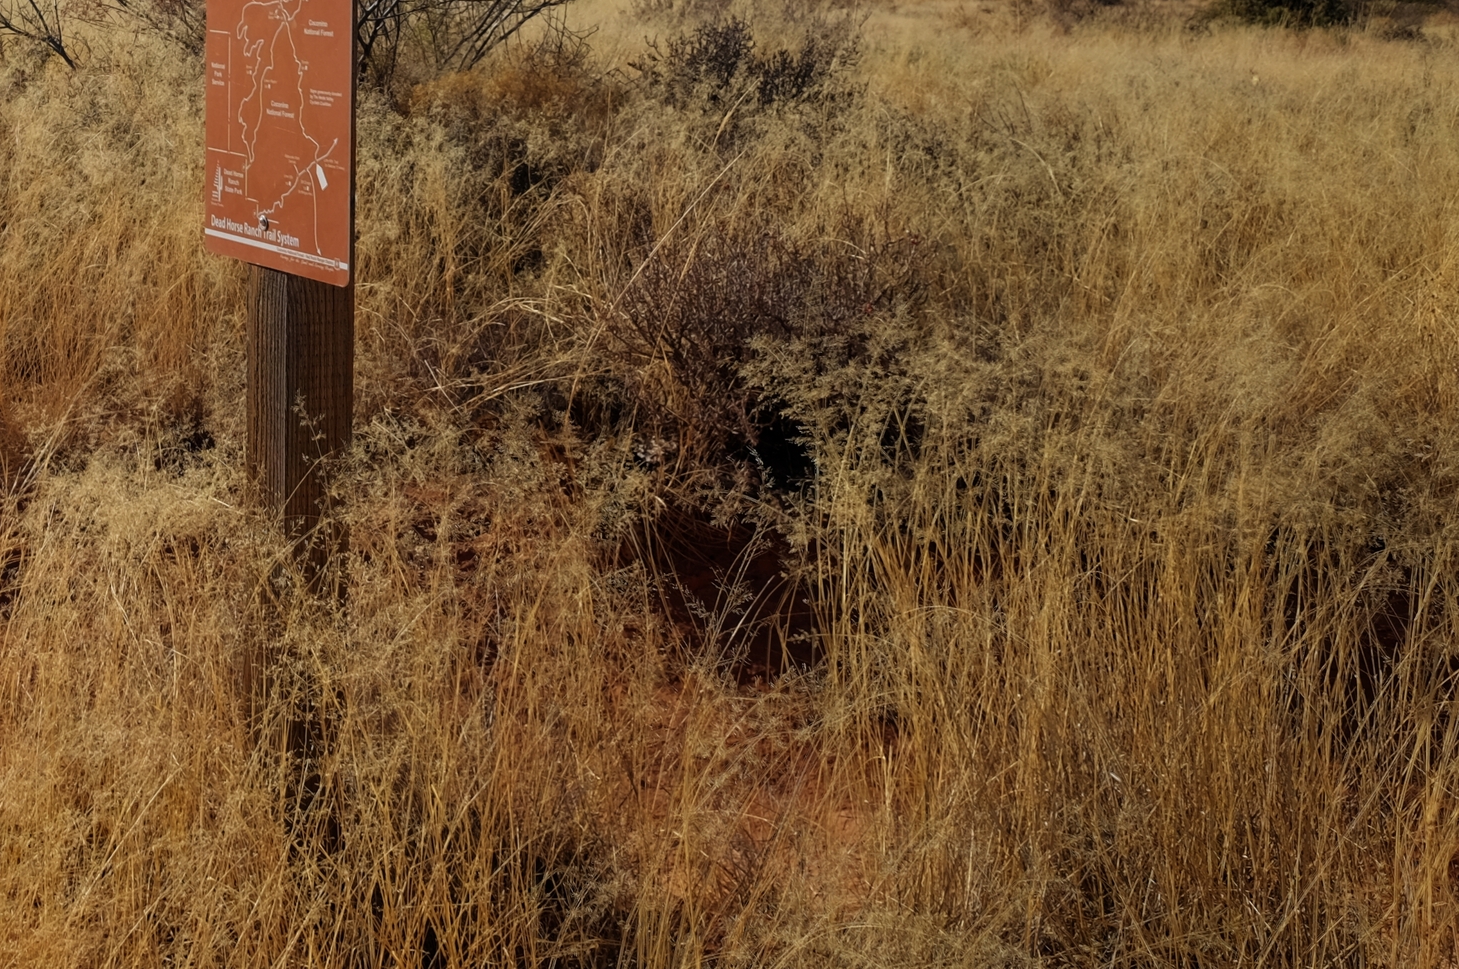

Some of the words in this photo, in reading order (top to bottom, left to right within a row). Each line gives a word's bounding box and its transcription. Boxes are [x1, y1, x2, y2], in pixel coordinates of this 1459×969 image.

[211, 214, 226, 229] Dead
[226, 218, 244, 234] Horse
[244, 222, 262, 238] Ranch
[262, 227, 277, 242] Trail
[277, 230, 300, 247] System
